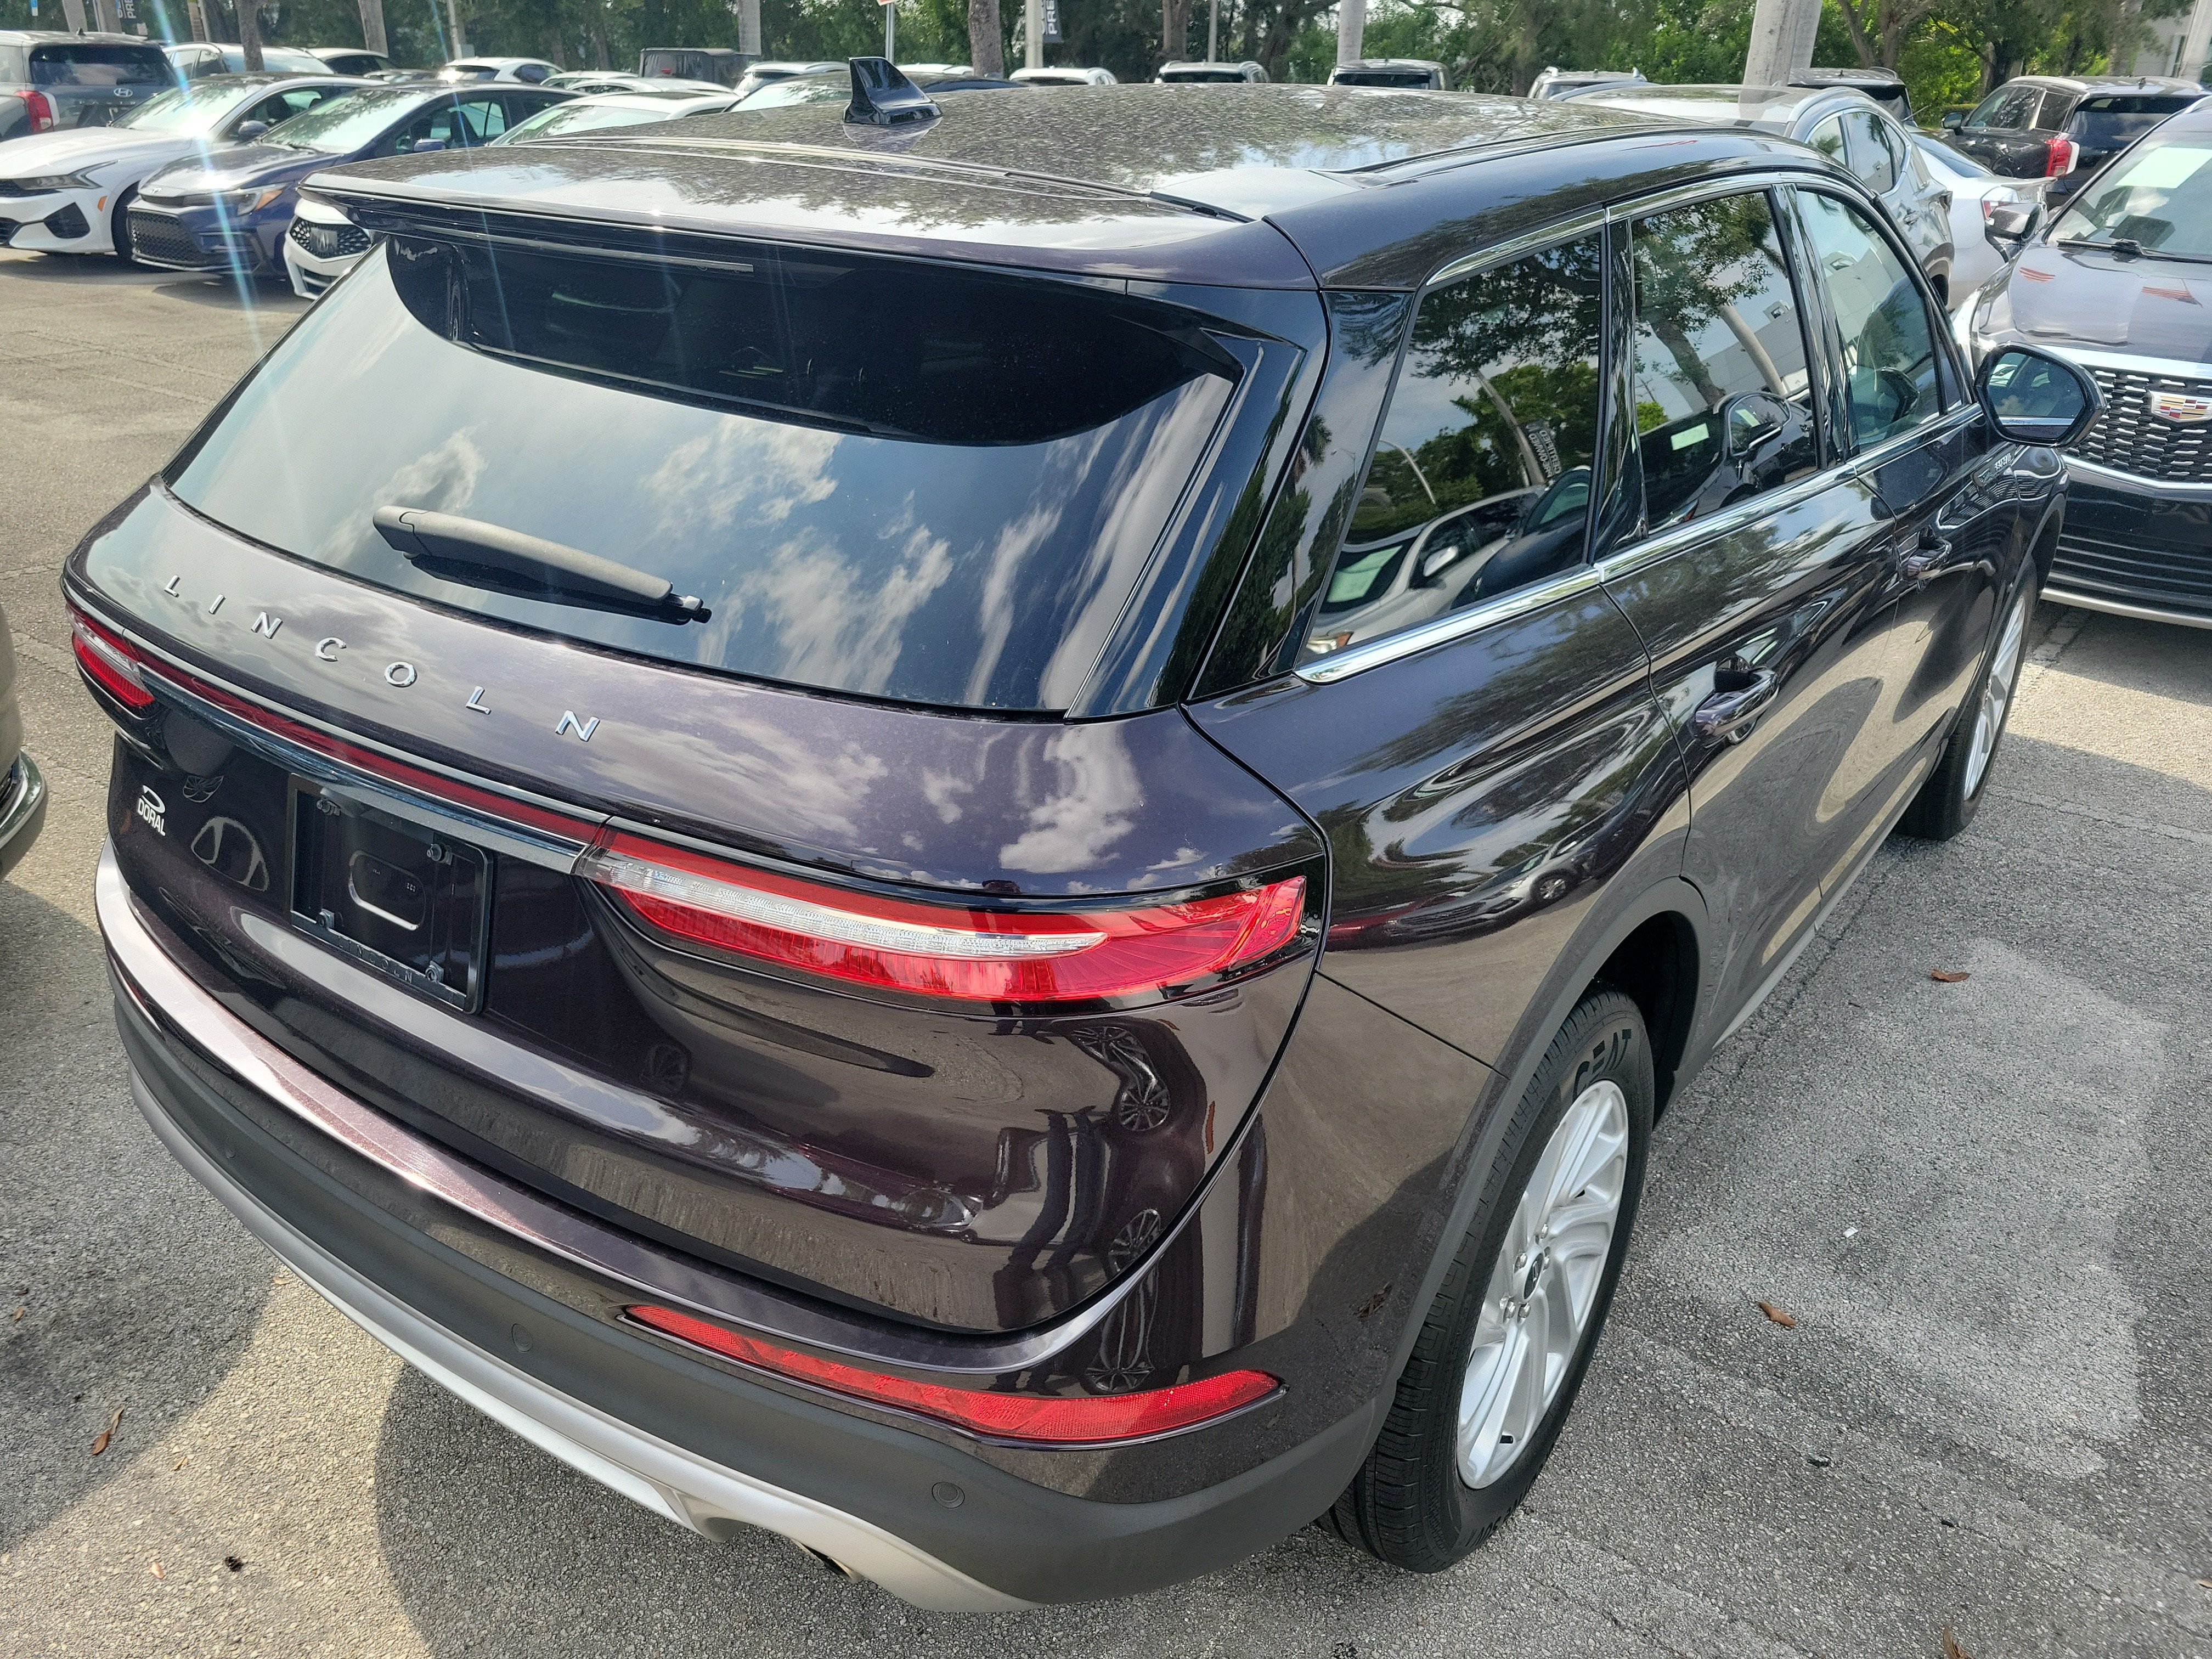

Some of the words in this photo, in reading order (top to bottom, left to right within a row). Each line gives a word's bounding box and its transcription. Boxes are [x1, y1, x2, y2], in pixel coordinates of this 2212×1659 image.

[164, 574, 600, 742] LINCOLN
[137, 797, 166, 836] DORAL
[337, 935, 413, 983] LINCOLN
[1572, 1029, 1632, 1103] CEAT
